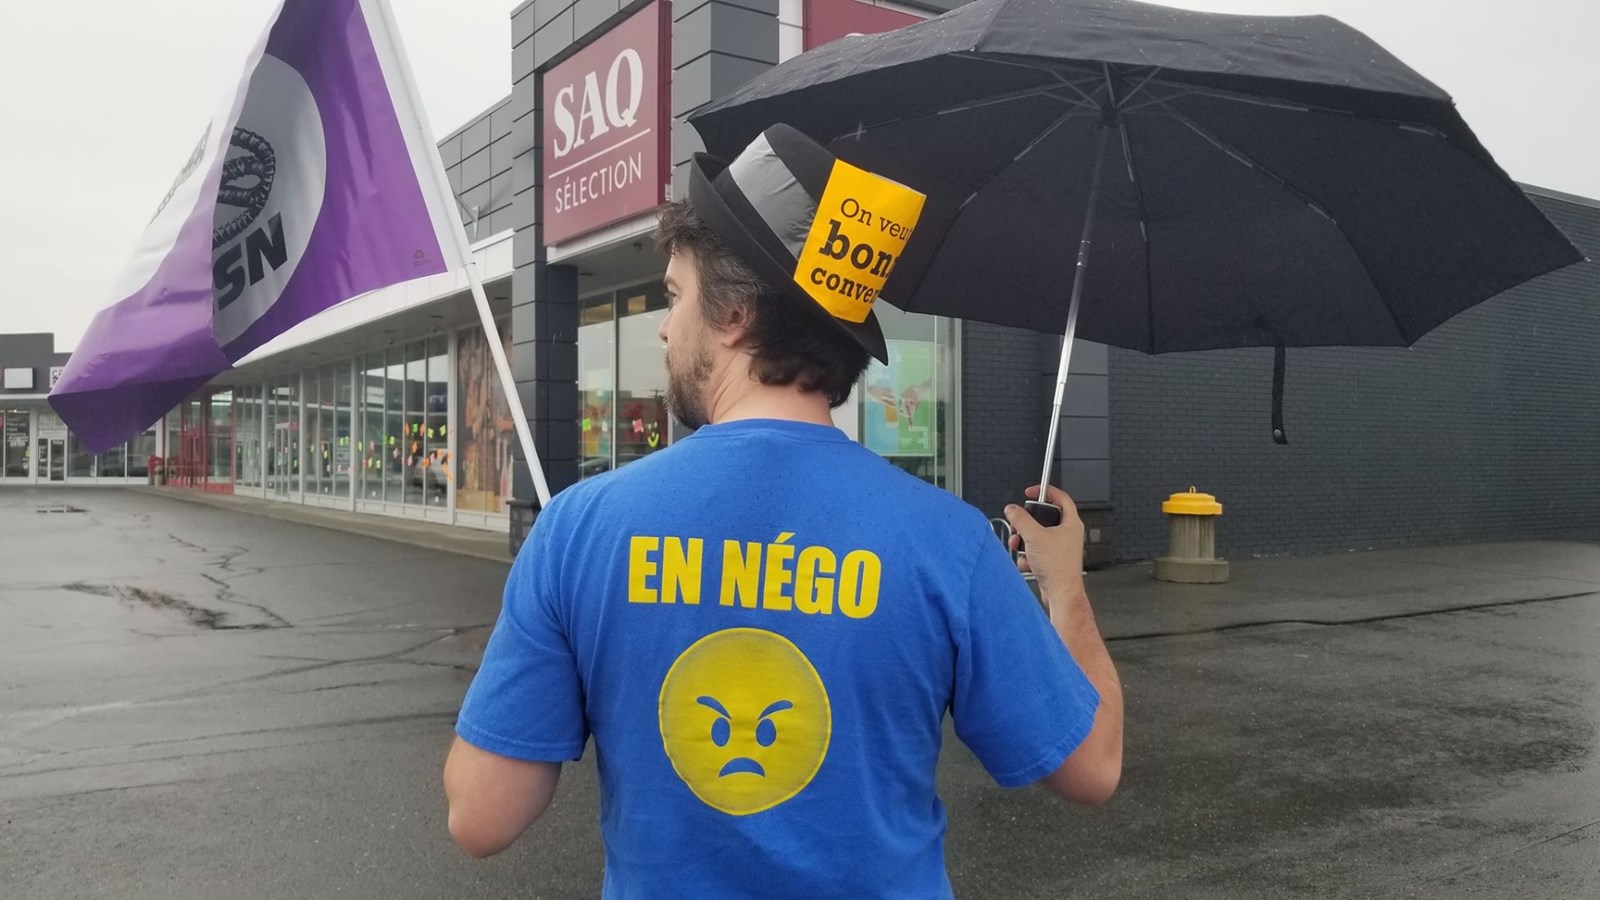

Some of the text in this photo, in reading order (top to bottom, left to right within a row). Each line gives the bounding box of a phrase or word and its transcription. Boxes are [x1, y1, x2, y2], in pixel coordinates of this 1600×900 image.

[554, 49, 643, 159] SAQ
[555, 152, 642, 213] SÉLECTION
[841, 198, 913, 241] On veu
[212, 211, 288, 318] SN
[819, 219, 898, 279] bon
[628, 531, 882, 619] EN NÉGO
